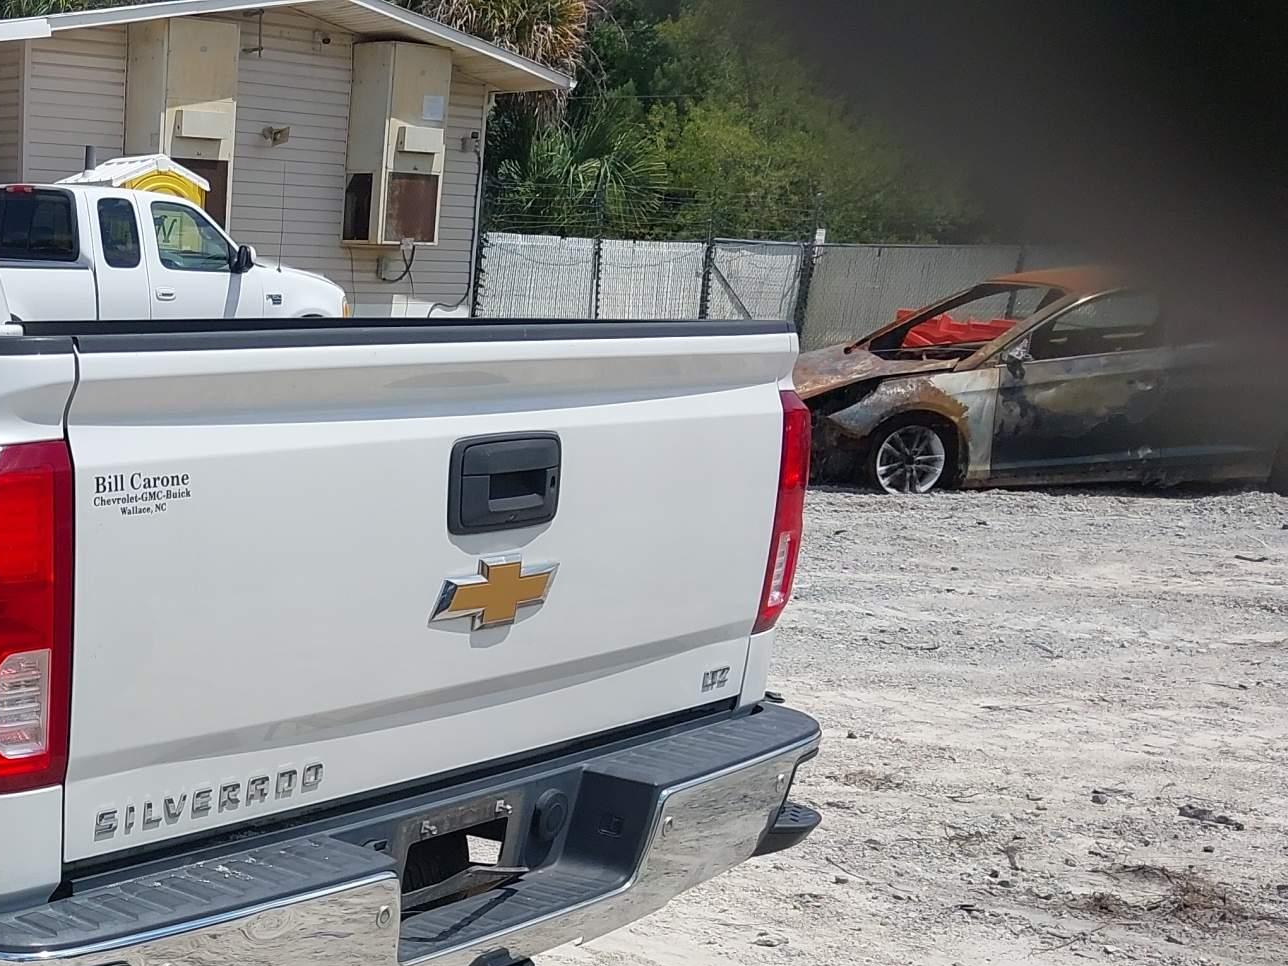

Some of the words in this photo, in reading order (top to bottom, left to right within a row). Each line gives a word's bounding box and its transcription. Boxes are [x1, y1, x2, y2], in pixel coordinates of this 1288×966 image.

[94, 474, 124, 494] Bill
[130, 472, 190, 490] Carone
[93, 488, 191, 507] Chevrolet-GMC-Buick
[120, 506, 153, 515] Wallace,
[155, 503, 167, 513] NC
[701, 666, 730, 690] LTZ
[95, 762, 324, 836] SILVERADO
